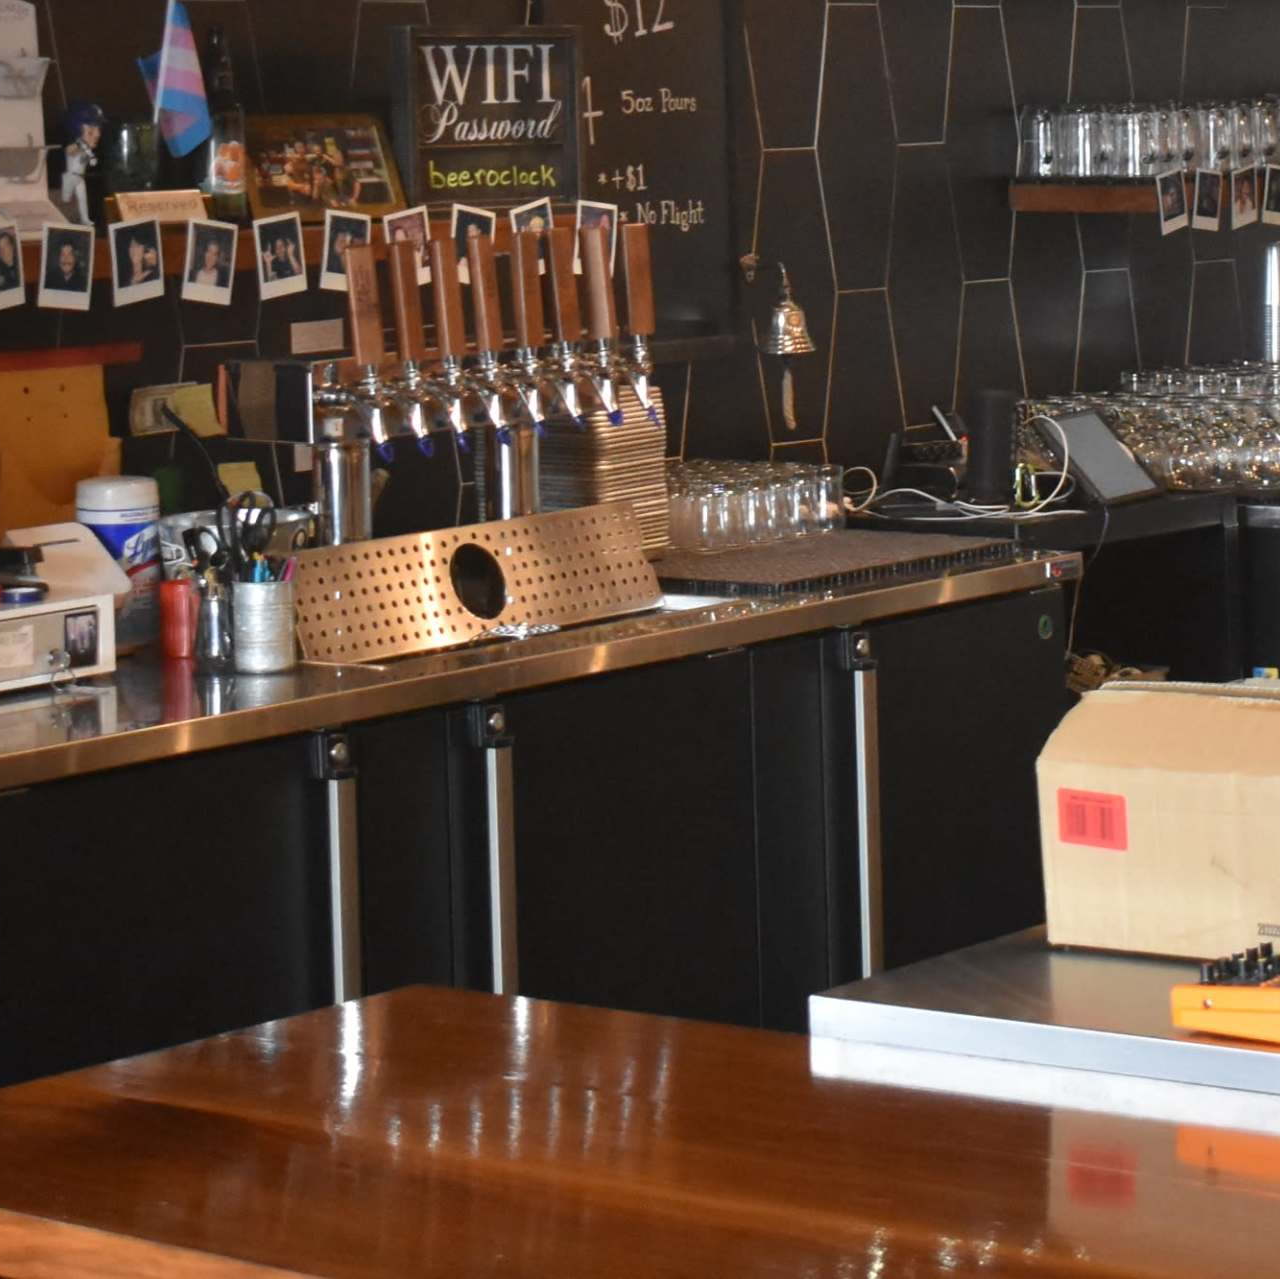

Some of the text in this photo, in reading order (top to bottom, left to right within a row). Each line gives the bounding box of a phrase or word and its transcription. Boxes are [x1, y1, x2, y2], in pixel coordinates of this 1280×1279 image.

[420, 44, 556, 106] WIFI
[621, 90, 653, 115] 5oz
[660, 88, 697, 114] Pours
[421, 100, 563, 144] Password
[428, 160, 557, 189] beeroclock
[636, 199, 705, 232] No Flight
